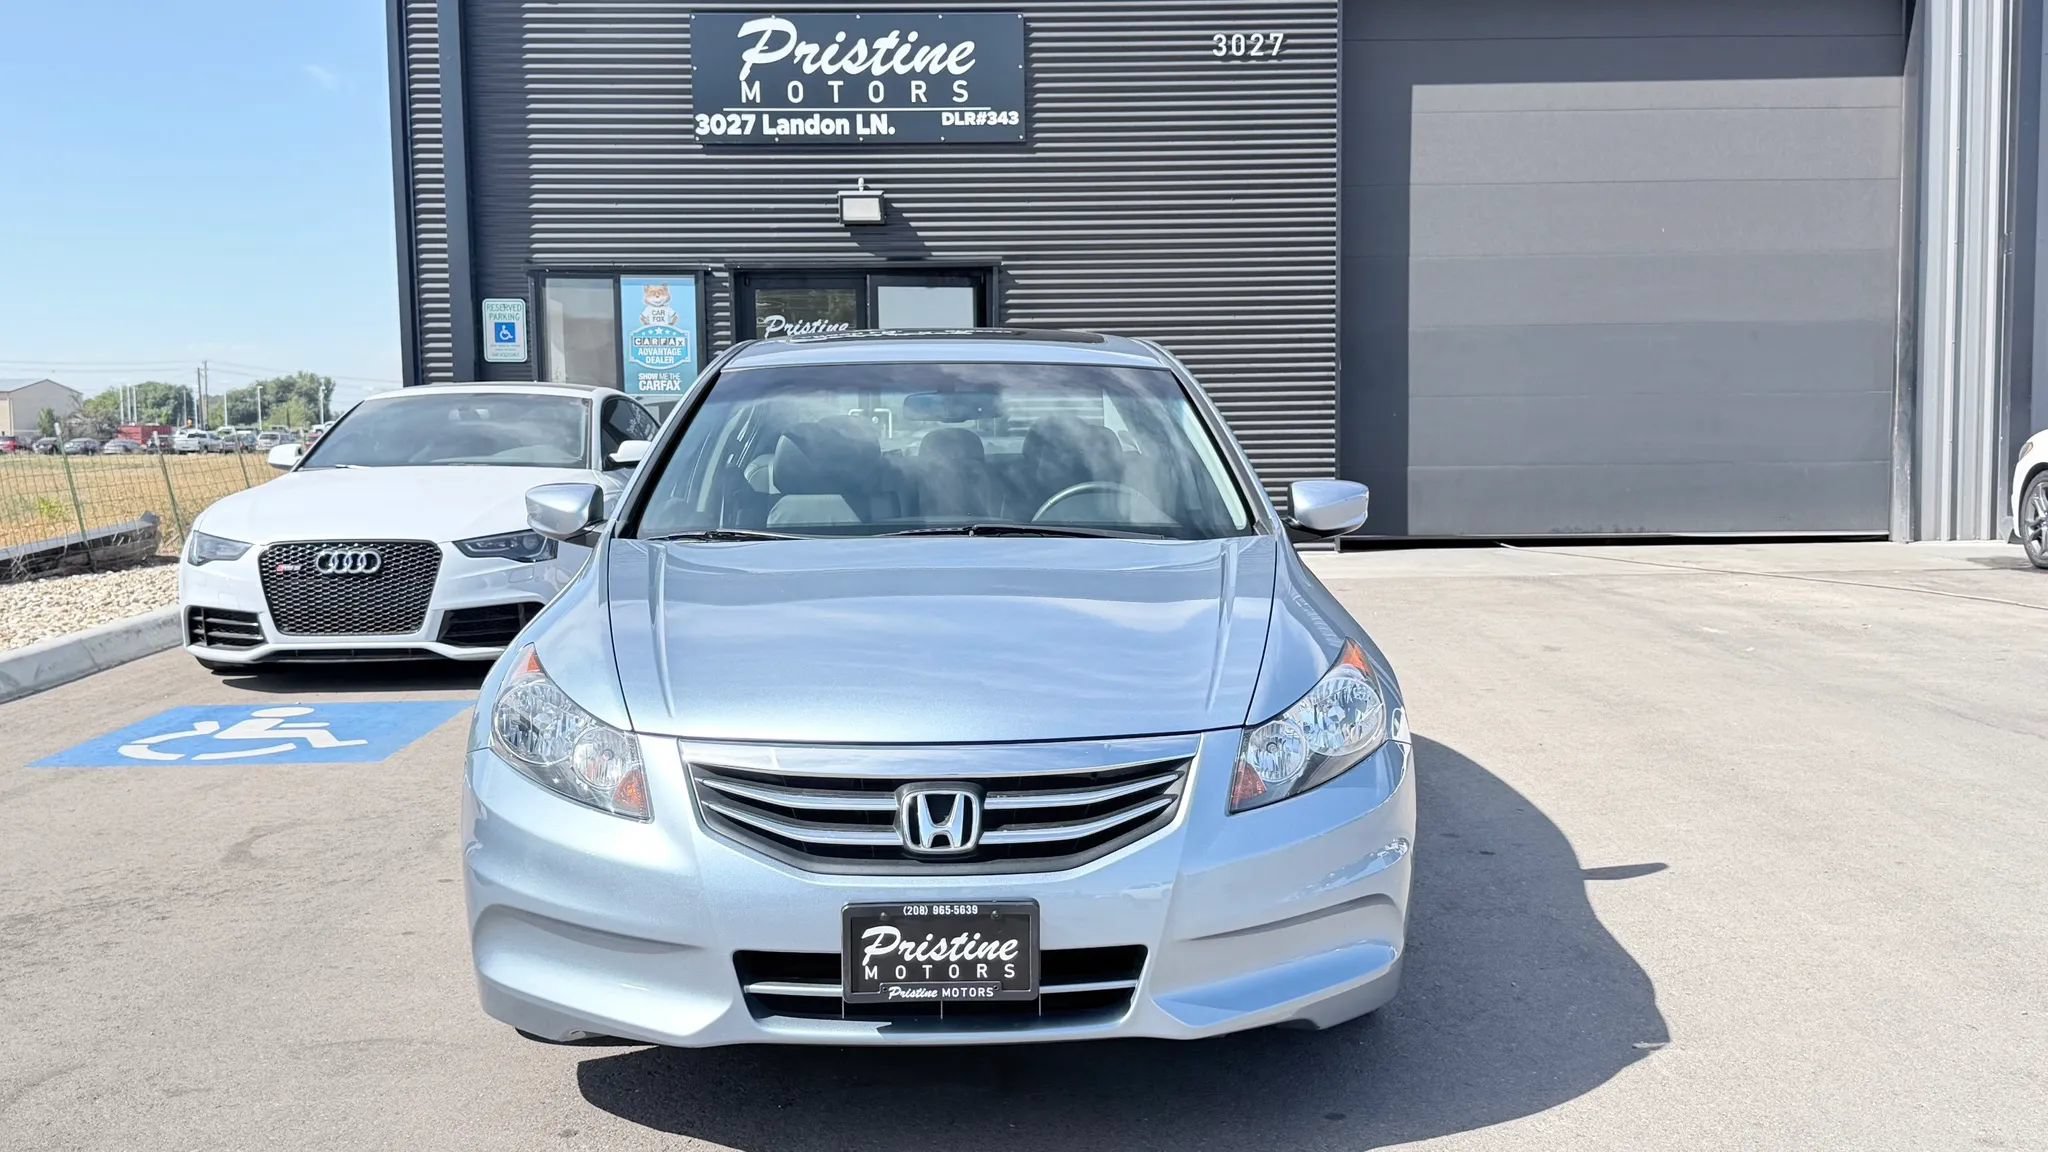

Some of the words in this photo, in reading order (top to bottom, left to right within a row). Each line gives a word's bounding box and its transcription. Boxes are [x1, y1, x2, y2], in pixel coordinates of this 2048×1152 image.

[737, 17, 976, 81] Pristine
[1212, 32, 1284, 57] 3027
[741, 80, 969, 103] MOTORS
[695, 114, 756, 136] 3027
[762, 113, 850, 136] Landon
[856, 113, 896, 136] LN.
[941, 111, 1020, 126] DLR#343
[486, 304, 522, 312] RESERVED
[489, 312, 521, 321] PARKING
[634, 337, 686, 346] CARFAX
[638, 348, 682, 356] ADVANTAGE
[639, 380, 680, 390] CARFAX
[903, 905, 929, 916] (208)
[932, 904, 978, 915] 965-5639
[861, 925, 1019, 967] Pristine
[864, 963, 1016, 980] MOTORS
[888, 985, 938, 1000] Pristine
[941, 985, 994, 998] MOTORS
